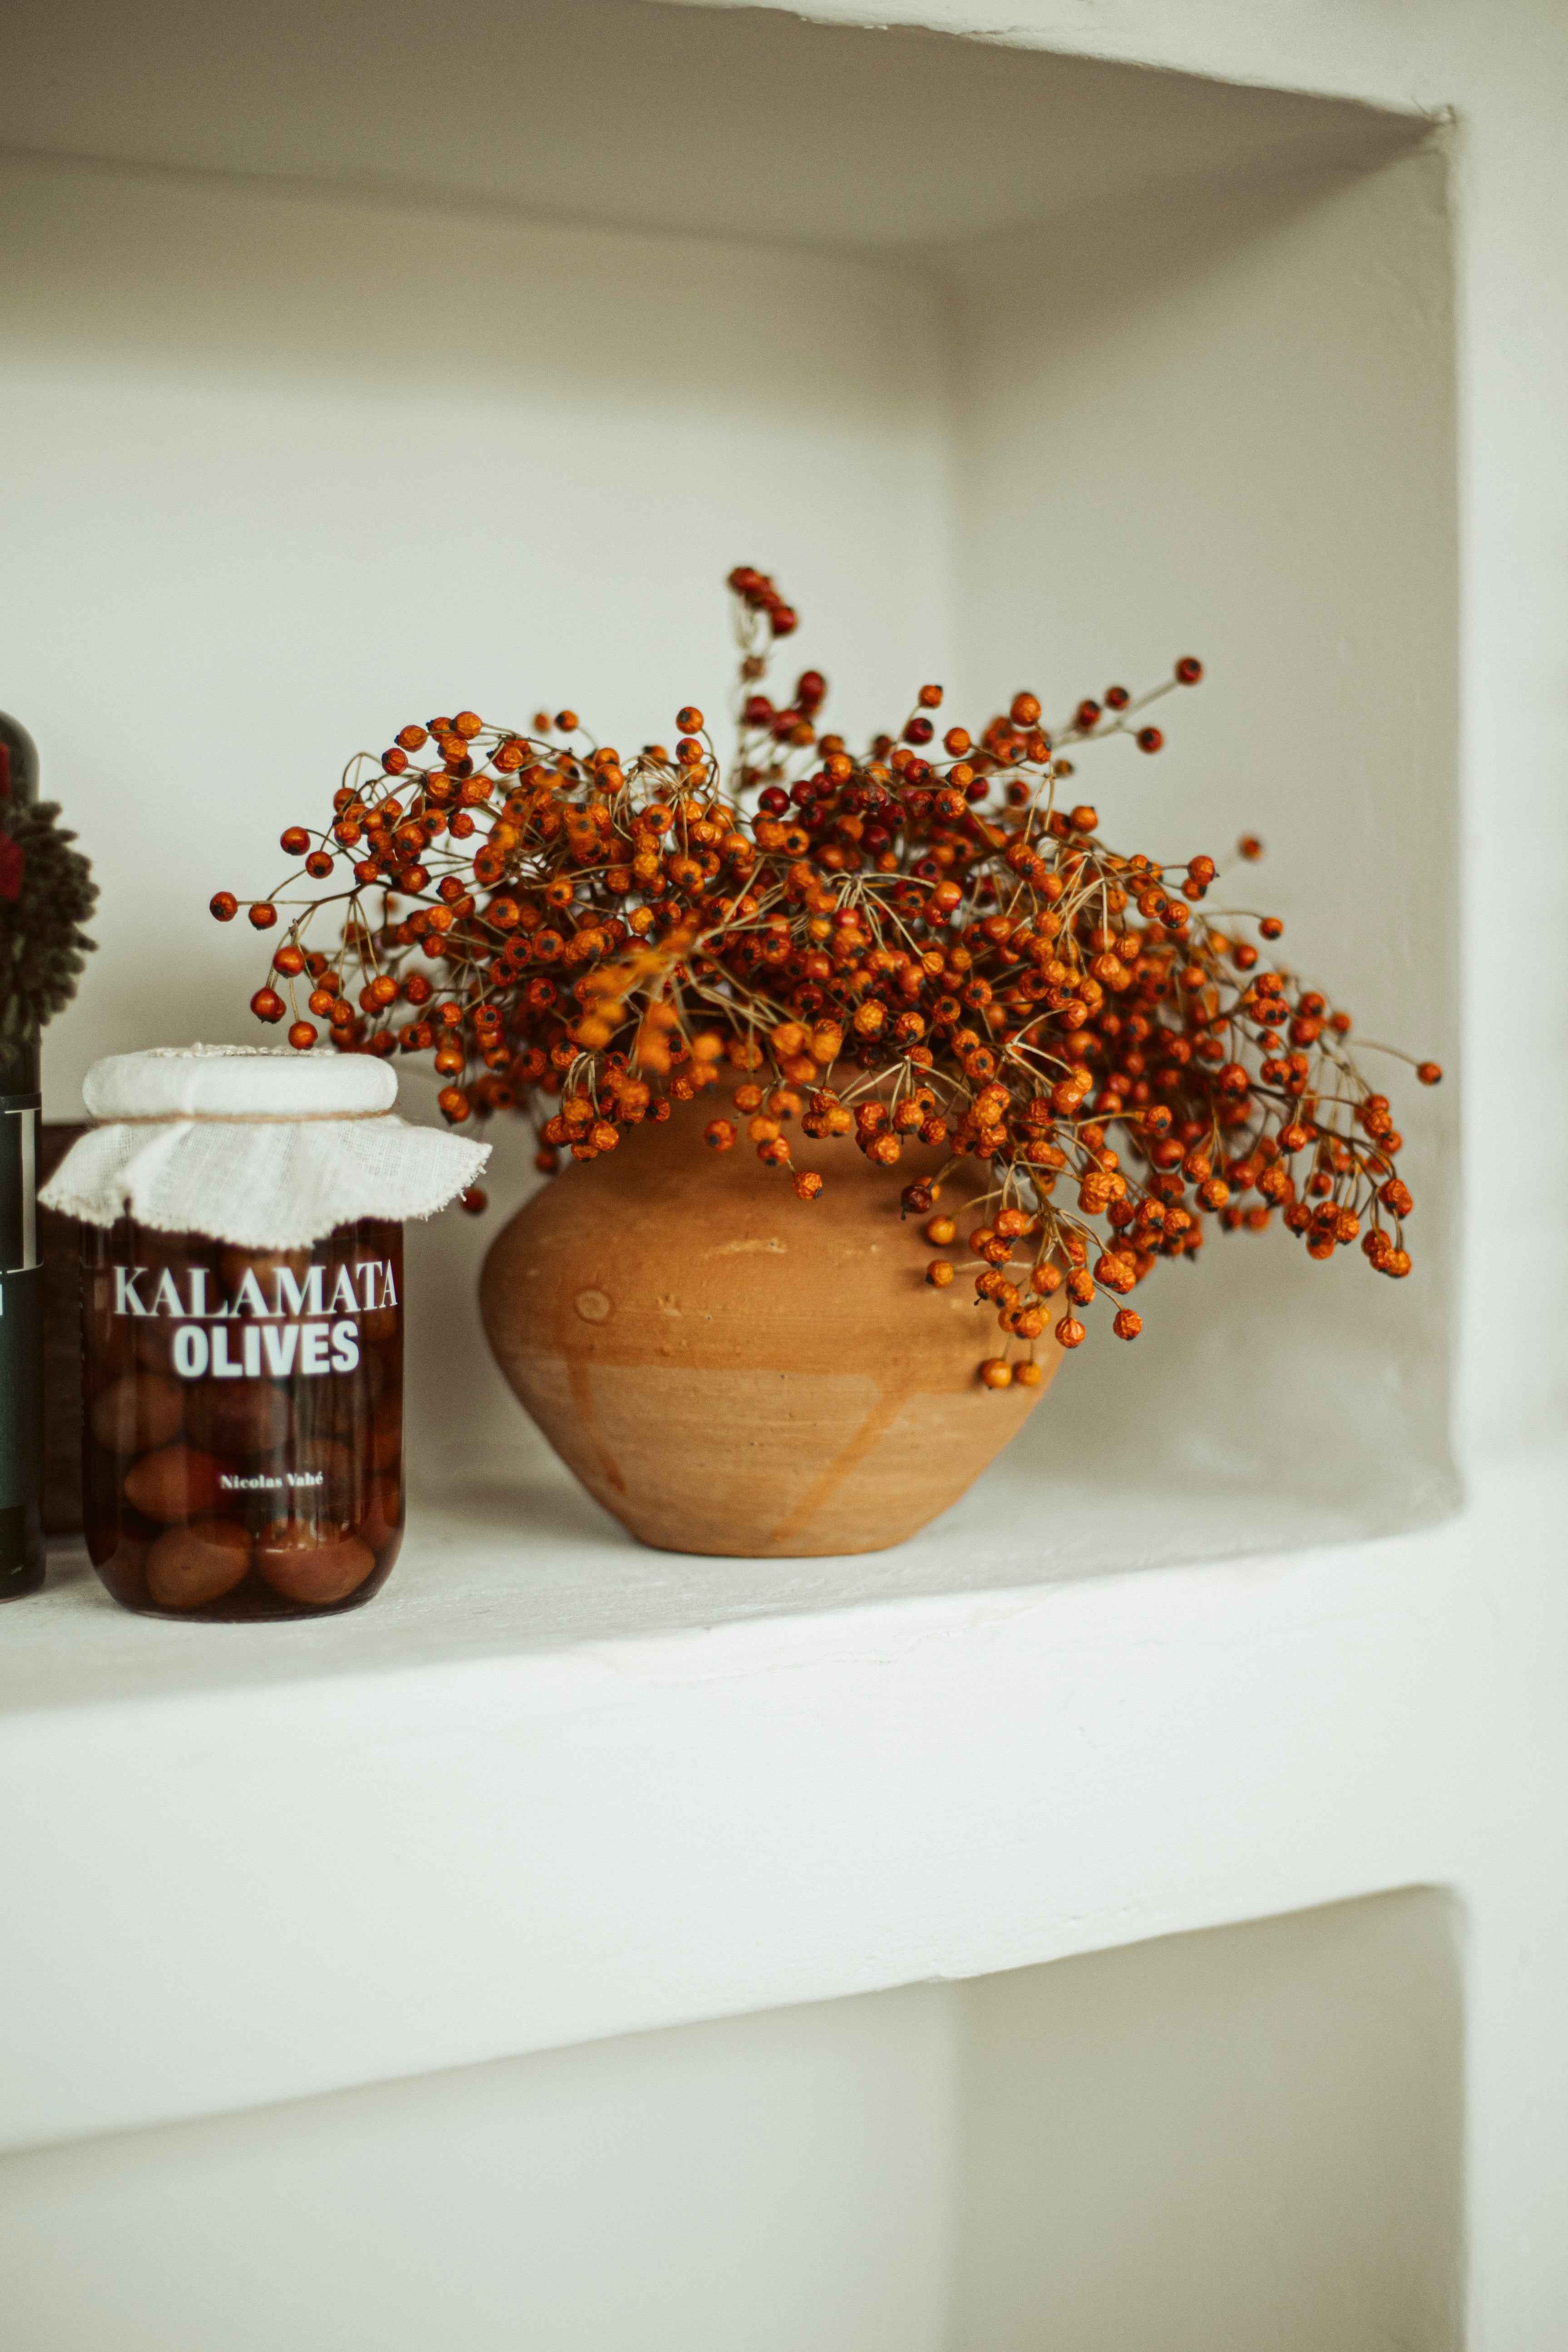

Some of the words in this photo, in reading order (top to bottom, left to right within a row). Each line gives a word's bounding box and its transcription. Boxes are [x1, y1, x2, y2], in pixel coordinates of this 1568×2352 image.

[113, 1259, 398, 1318] KALAMATA
[173, 1320, 359, 1378] OLIVES
[221, 1474, 283, 1489] Nicolas
[286, 1471, 324, 1487] Vahé
